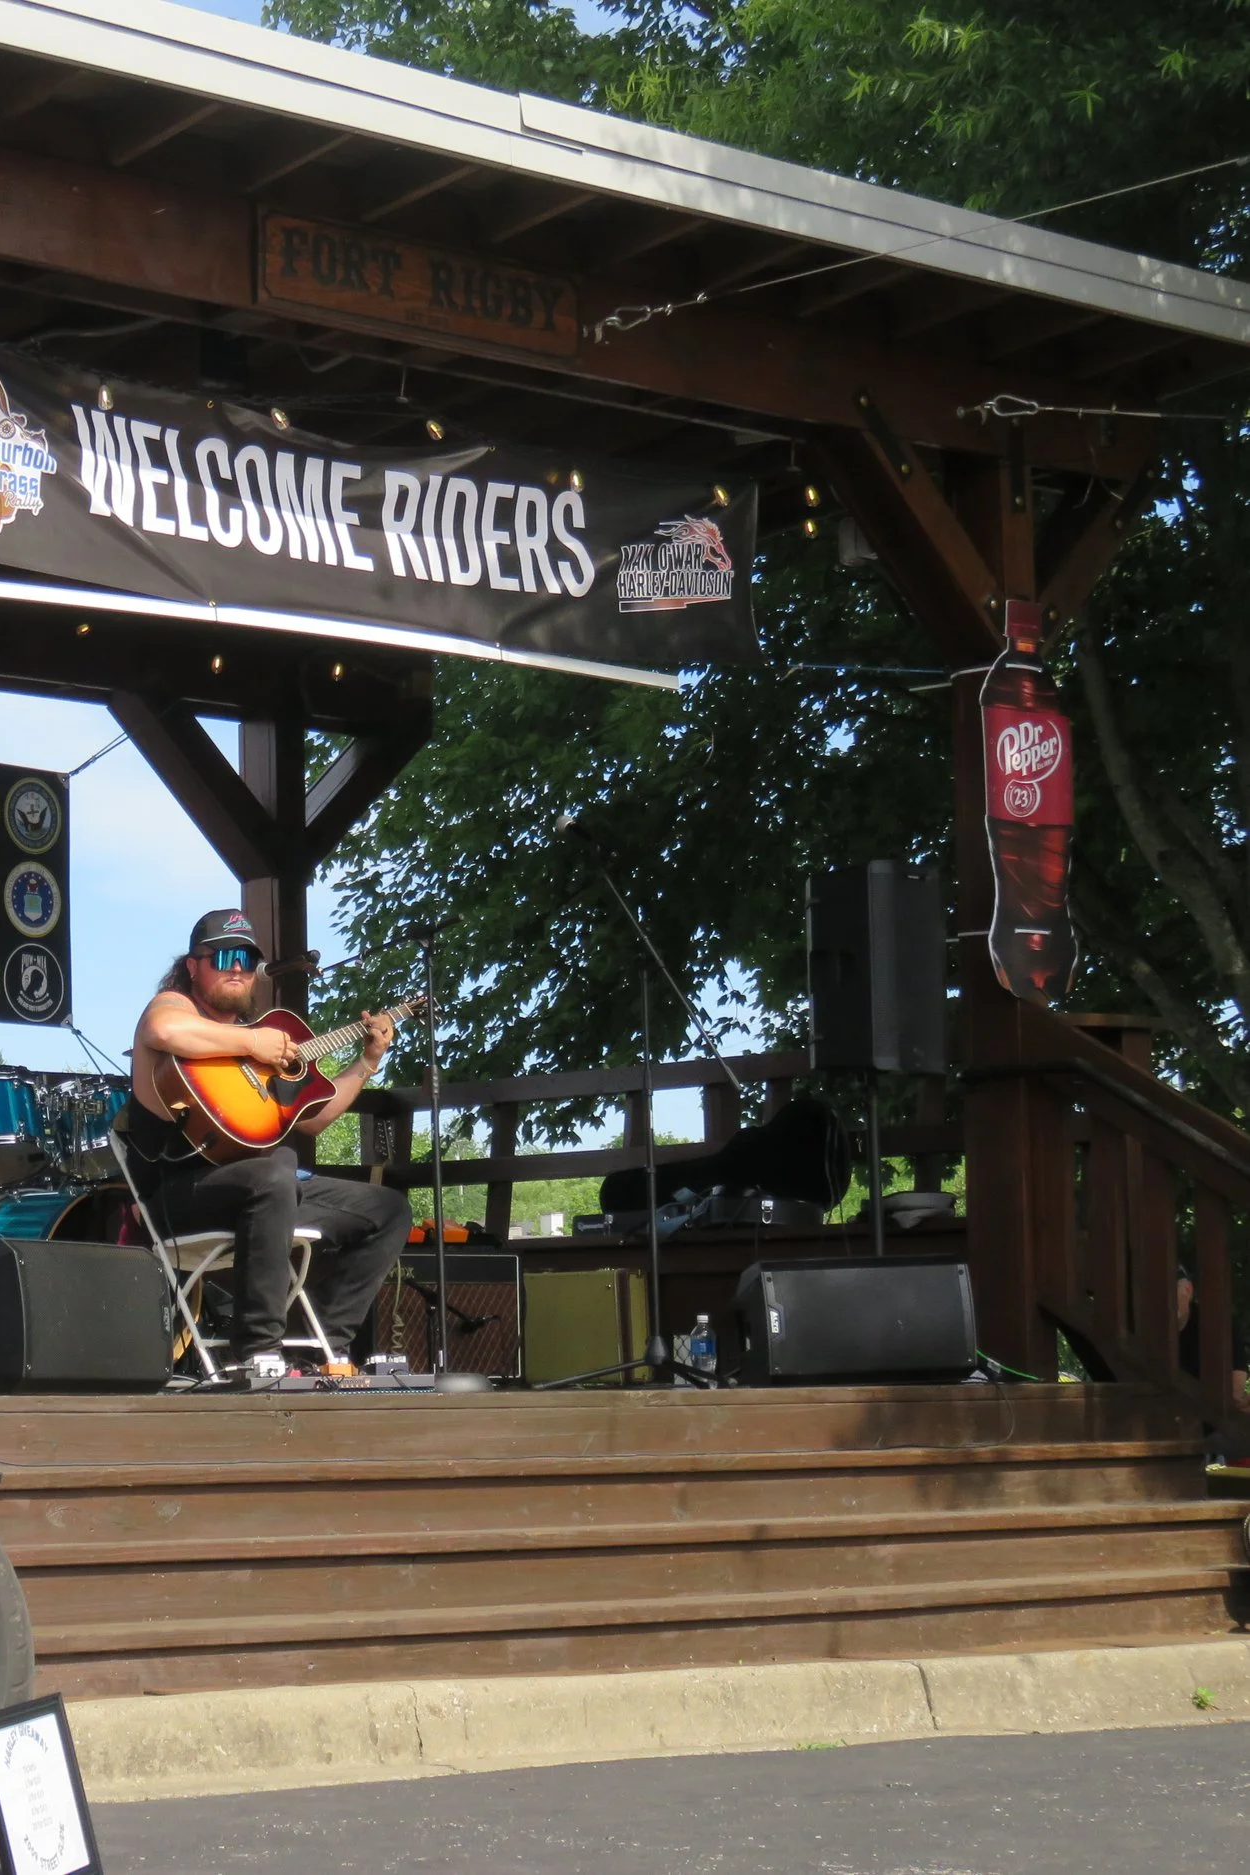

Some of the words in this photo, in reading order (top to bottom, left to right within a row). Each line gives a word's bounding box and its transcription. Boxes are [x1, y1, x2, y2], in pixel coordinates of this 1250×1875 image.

[280, 225, 401, 298] FORT
[430, 252, 567, 332] RIGBY
[4, 491, 44, 515] Rally
[70, 404, 374, 571] WELCOME
[381, 469, 595, 598] RIDERS
[619, 544, 655, 572] MAN
[657, 543, 704, 571] O'WAR
[617, 571, 733, 599] HARLEY-DAVIDSON
[1019, 722, 1043, 751] Dr
[1000, 727, 1058, 776] Pepper
[1013, 787, 1029, 808] 23
